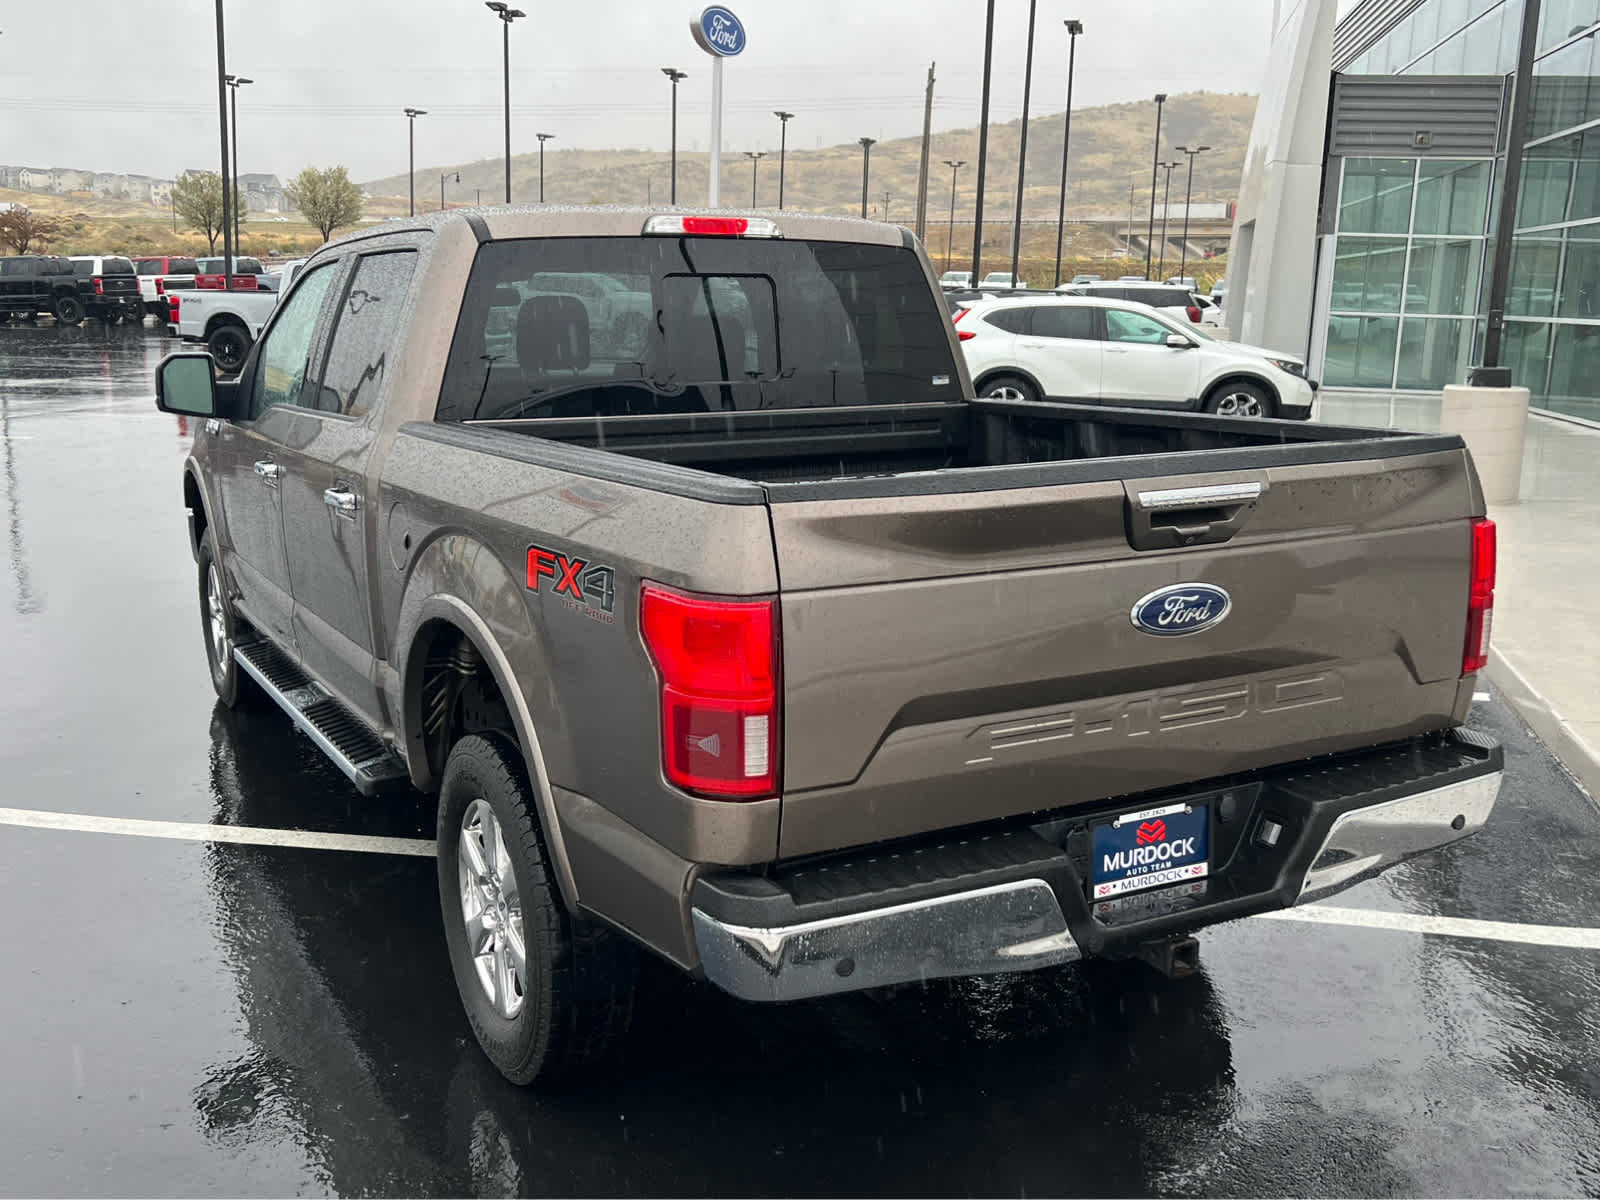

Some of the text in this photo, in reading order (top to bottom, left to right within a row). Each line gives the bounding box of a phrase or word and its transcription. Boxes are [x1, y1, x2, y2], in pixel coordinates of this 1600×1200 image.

[710, 14, 738, 48] Ford
[526, 544, 615, 613] FX4
[1157, 595, 1212, 626] Ford
[965, 671, 1343, 765] F-150
[1103, 837, 1195, 872] MURDOCK
[1126, 860, 1172, 877] AUTO TEAM
[1121, 869, 1182, 890] MURDOCK
